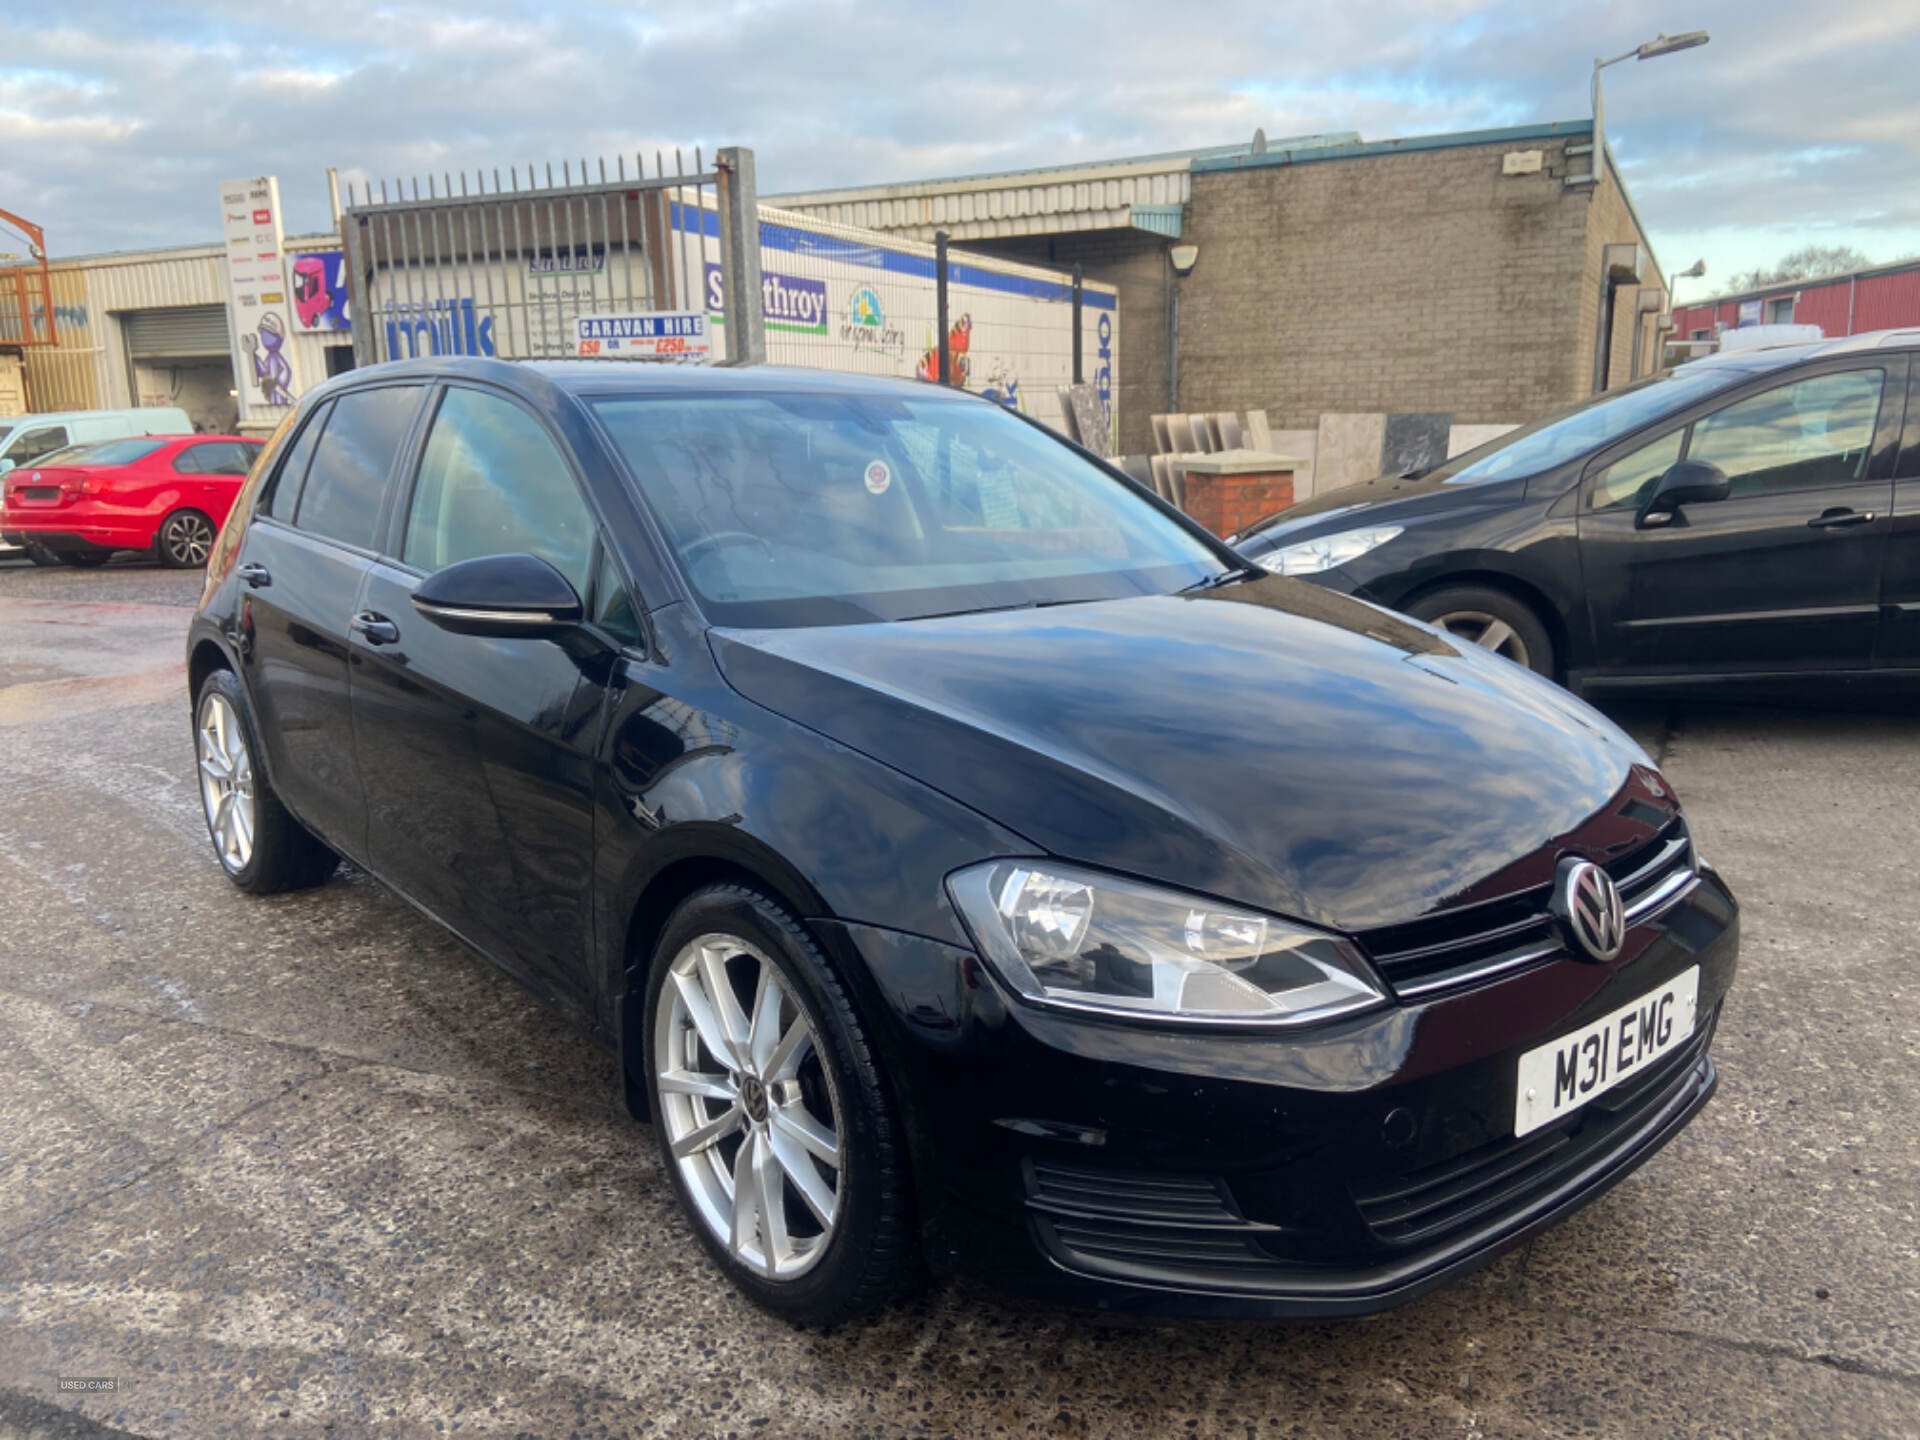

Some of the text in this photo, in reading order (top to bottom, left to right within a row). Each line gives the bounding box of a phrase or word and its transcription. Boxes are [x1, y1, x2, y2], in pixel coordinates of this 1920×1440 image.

[580, 317, 702, 338] CARAVAN HIRE
[708, 270, 824, 327] Sthroy
[385, 297, 495, 361] milk
[1554, 992, 1674, 1109] M31 EMG
